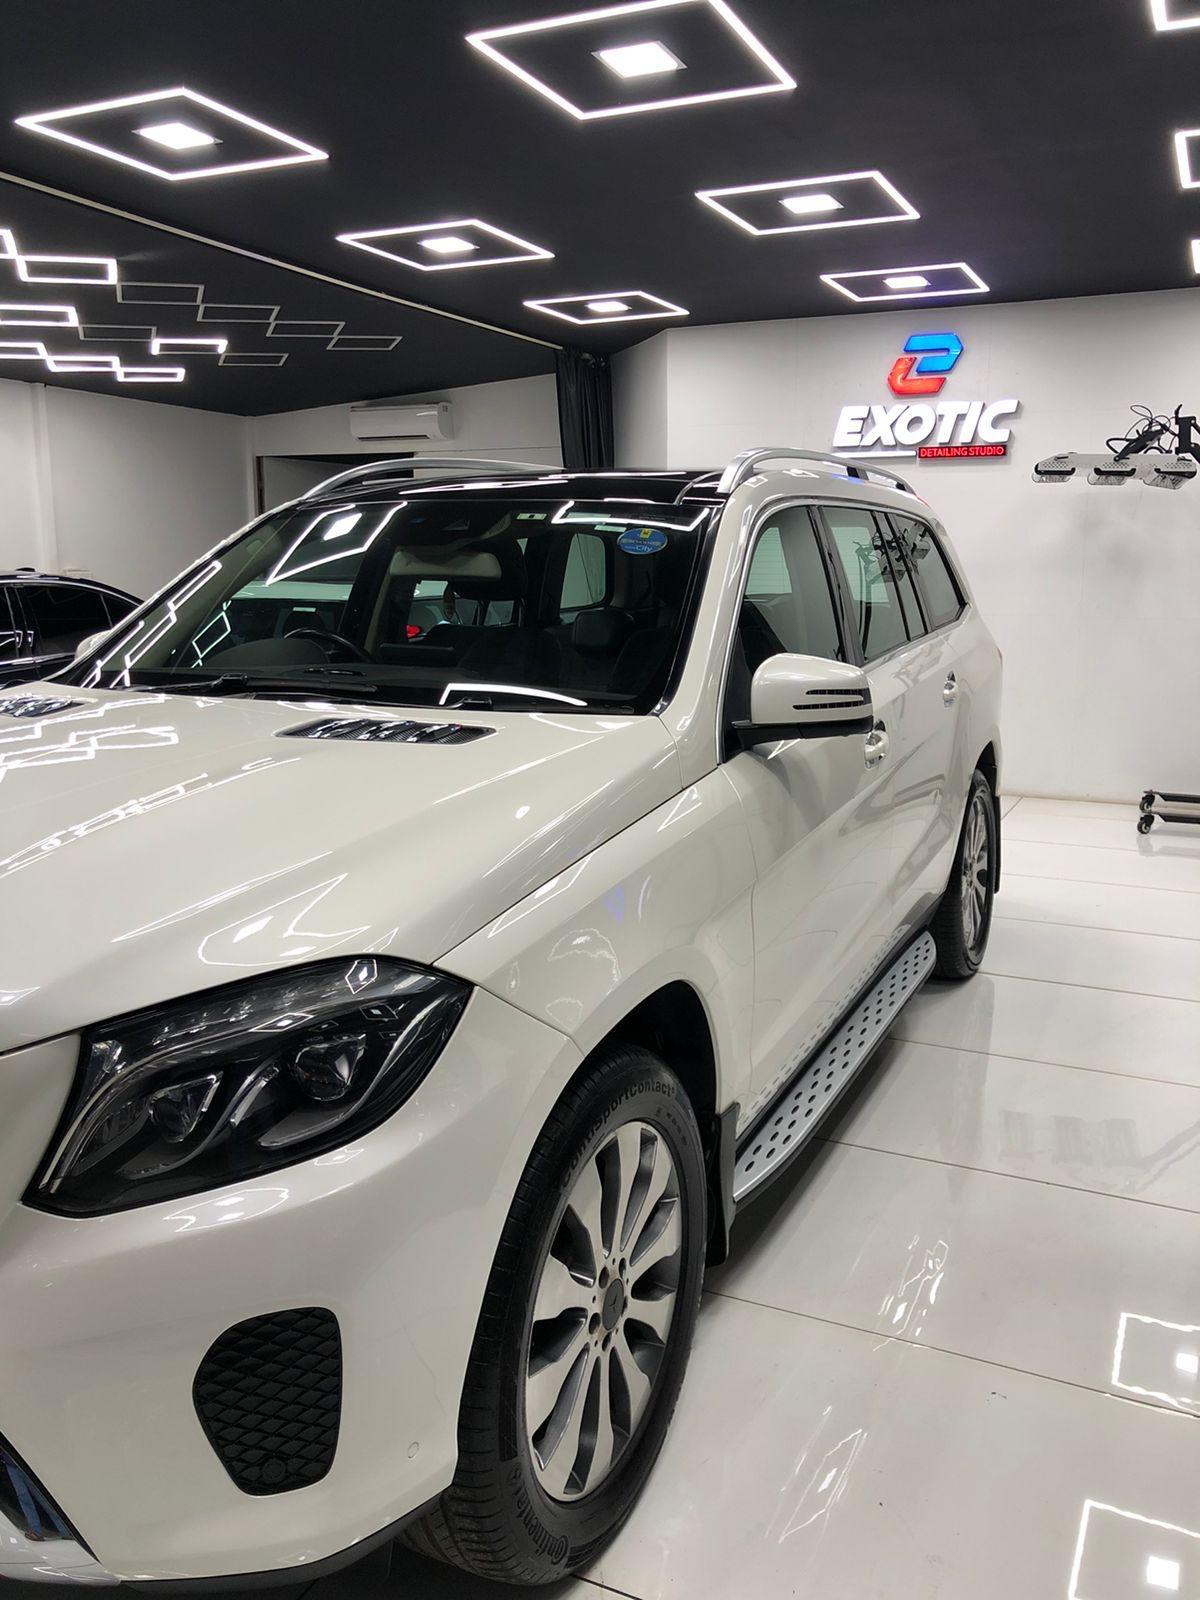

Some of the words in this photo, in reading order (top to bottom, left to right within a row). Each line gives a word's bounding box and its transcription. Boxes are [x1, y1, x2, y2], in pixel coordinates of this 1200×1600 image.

[832, 399, 1020, 447] EXOTIC
[920, 447, 968, 457] DETAILING
[968, 446, 1005, 456] STUDIO
